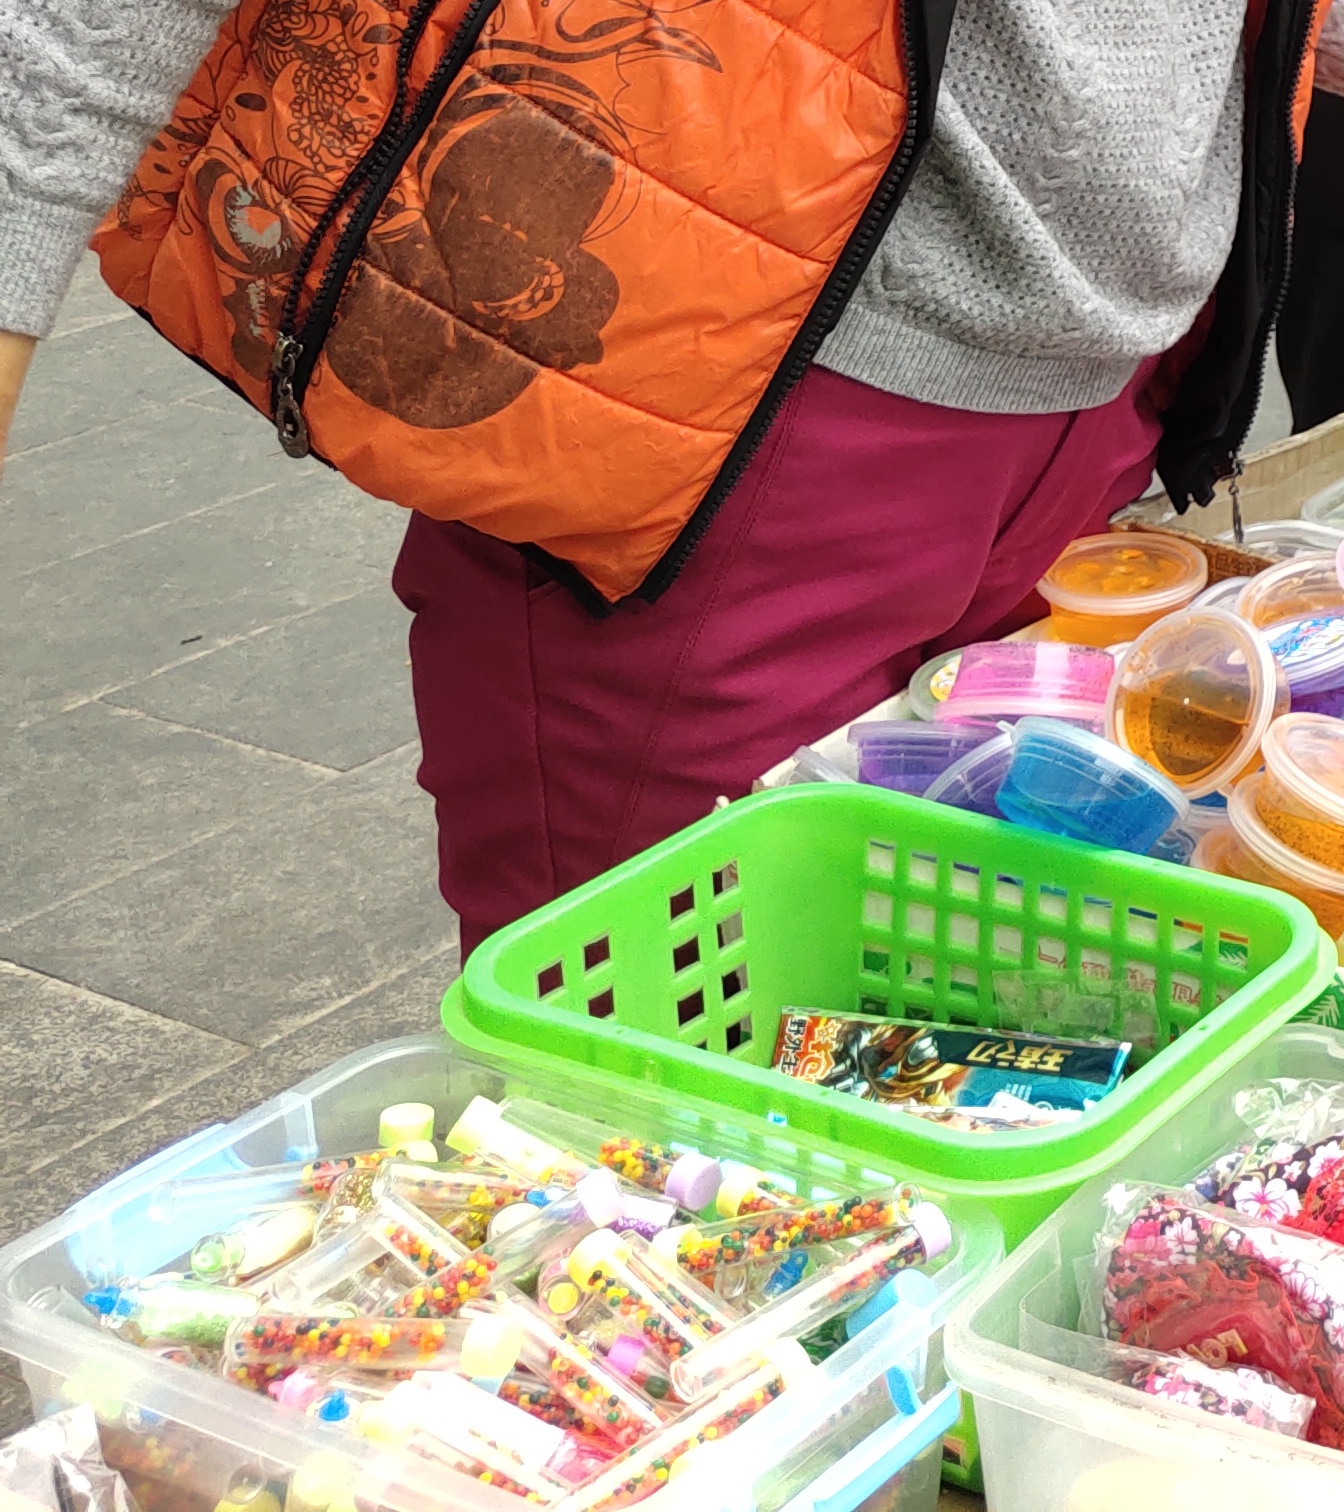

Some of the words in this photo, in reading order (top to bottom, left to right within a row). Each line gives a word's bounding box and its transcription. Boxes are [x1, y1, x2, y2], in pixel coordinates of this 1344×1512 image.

[780, 1015, 808, 1076] 野外生
[966, 1040, 1074, 1073] 王者之刃
